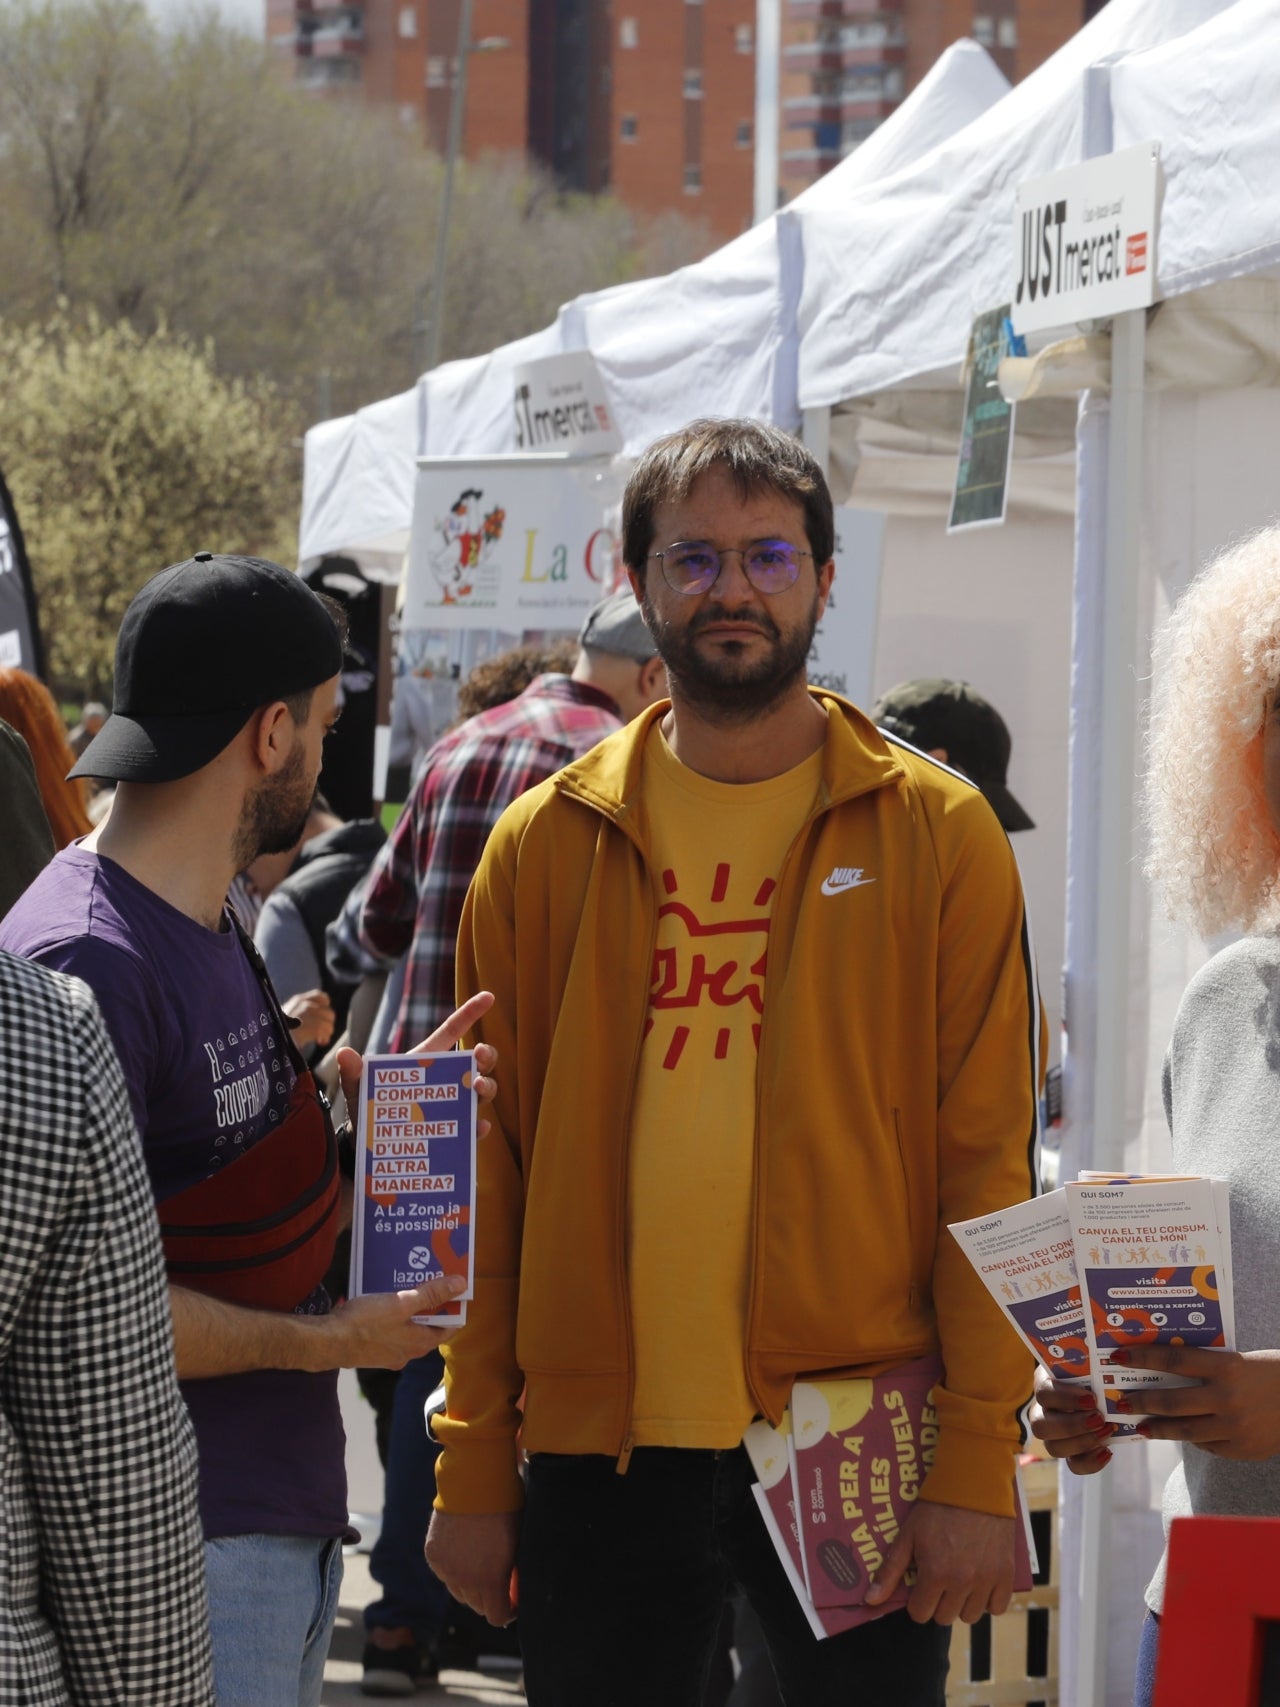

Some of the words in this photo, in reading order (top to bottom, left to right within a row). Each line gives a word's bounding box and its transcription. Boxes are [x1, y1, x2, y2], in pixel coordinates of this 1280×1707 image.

[1016, 200, 1067, 304] JUST
[1064, 224, 1120, 291] mercat
[519, 528, 568, 583] La
[828, 867, 864, 884] NIKE
[377, 1069, 420, 1084] VOLS
[376, 1086, 457, 1101] COMPRAR
[376, 1106, 409, 1120] PER
[375, 1121, 457, 1138] INTERNET
[375, 1142, 427, 1156] D'UNA
[374, 1159, 428, 1174] ALTRA
[374, 1176, 453, 1192] MANERA?
[374, 1205, 385, 1217] A
[388, 1204, 405, 1216] La
[408, 1203, 445, 1216] Zona
[446, 1201, 460, 1217] ja
[375, 1218, 392, 1232] és
[395, 1217, 459, 1235] possible!
[964, 1228, 980, 1236] QUI
[980, 1220, 1002, 1232] SOM?
[1078, 1227, 1120, 1236] CANVIA
[1121, 1227, 1134, 1235] EL
[1136, 1226, 1157, 1234] TEU
[1159, 1224, 1209, 1234] CONSUM.
[1102, 1236, 1142, 1244] CANVIA
[1160, 1234, 1187, 1242] MÓN!
[981, 1260, 1017, 1273] CANVIA
[1017, 1256, 1030, 1265] EL
[1030, 1248, 1049, 1260] TEU
[1005, 1262, 1042, 1277] CANVIA
[1042, 1258, 1055, 1266] EL
[393, 1269, 445, 1284] lazona
[1135, 1277, 1167, 1286] visita
[1110, 1288, 1194, 1296] www.lazona.coop
[1054, 1298, 1082, 1312] visita
[1109, 1303, 1164, 1311] segueix-nos
[843, 1435, 865, 1456] A
[884, 1390, 920, 1502] CRUELS
[813, 1467, 824, 1510] connexió
[839, 1460, 864, 1520] PER
[810, 1488, 818, 1510] som
